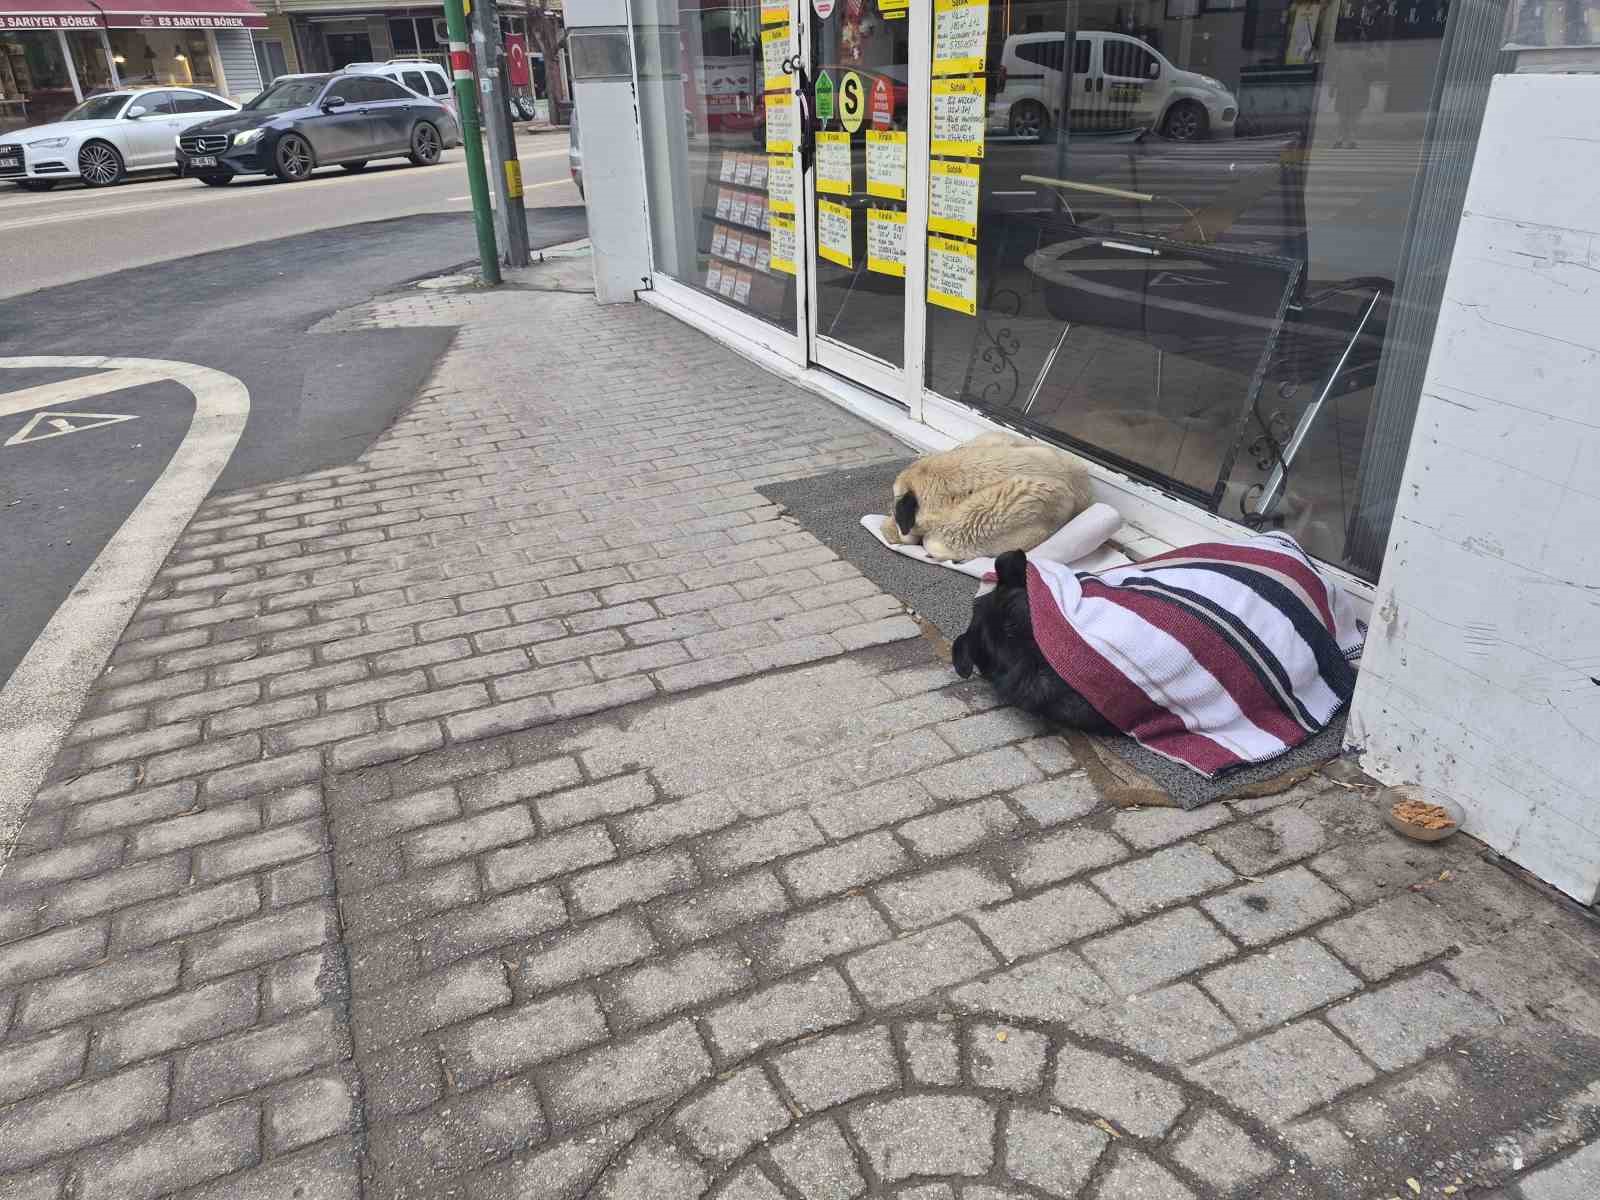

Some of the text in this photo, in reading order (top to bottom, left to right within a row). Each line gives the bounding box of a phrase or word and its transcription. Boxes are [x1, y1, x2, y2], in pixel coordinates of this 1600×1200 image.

[8, 16, 57, 27] SARIYER
[60, 15, 98, 27] BÖREK
[158, 16, 244, 27] ES SARIYER BÖREK
[845, 79, 857, 114] S
